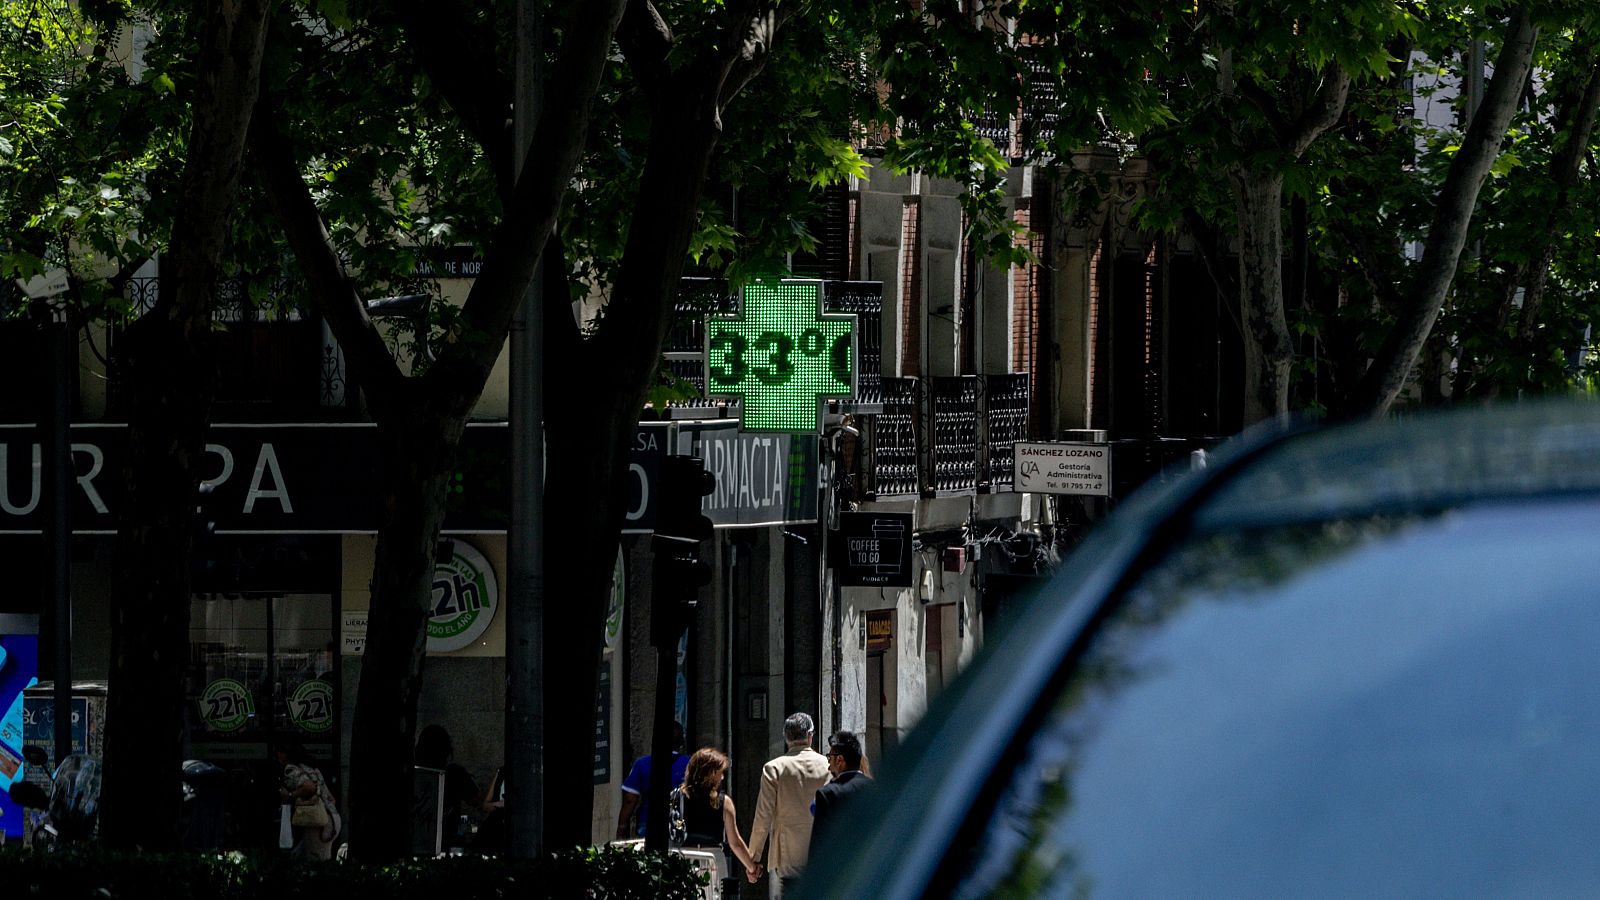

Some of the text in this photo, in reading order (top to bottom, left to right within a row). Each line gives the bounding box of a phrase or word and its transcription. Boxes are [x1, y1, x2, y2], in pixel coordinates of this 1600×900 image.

[445, 262, 456, 274] DE
[461, 261, 483, 274] NOB
[1021, 447, 1103, 458] SÁNCHEZ LOZANO
[699, 437, 783, 510] ARMACIA
[1046, 471, 1103, 480] Administrativa
[1046, 481, 1058, 489] Tel.
[850, 539, 880, 551] COFFEE
[857, 552, 880, 564] TO GO
[428, 574, 480, 617] 2h
[207, 693, 249, 720] 22h
